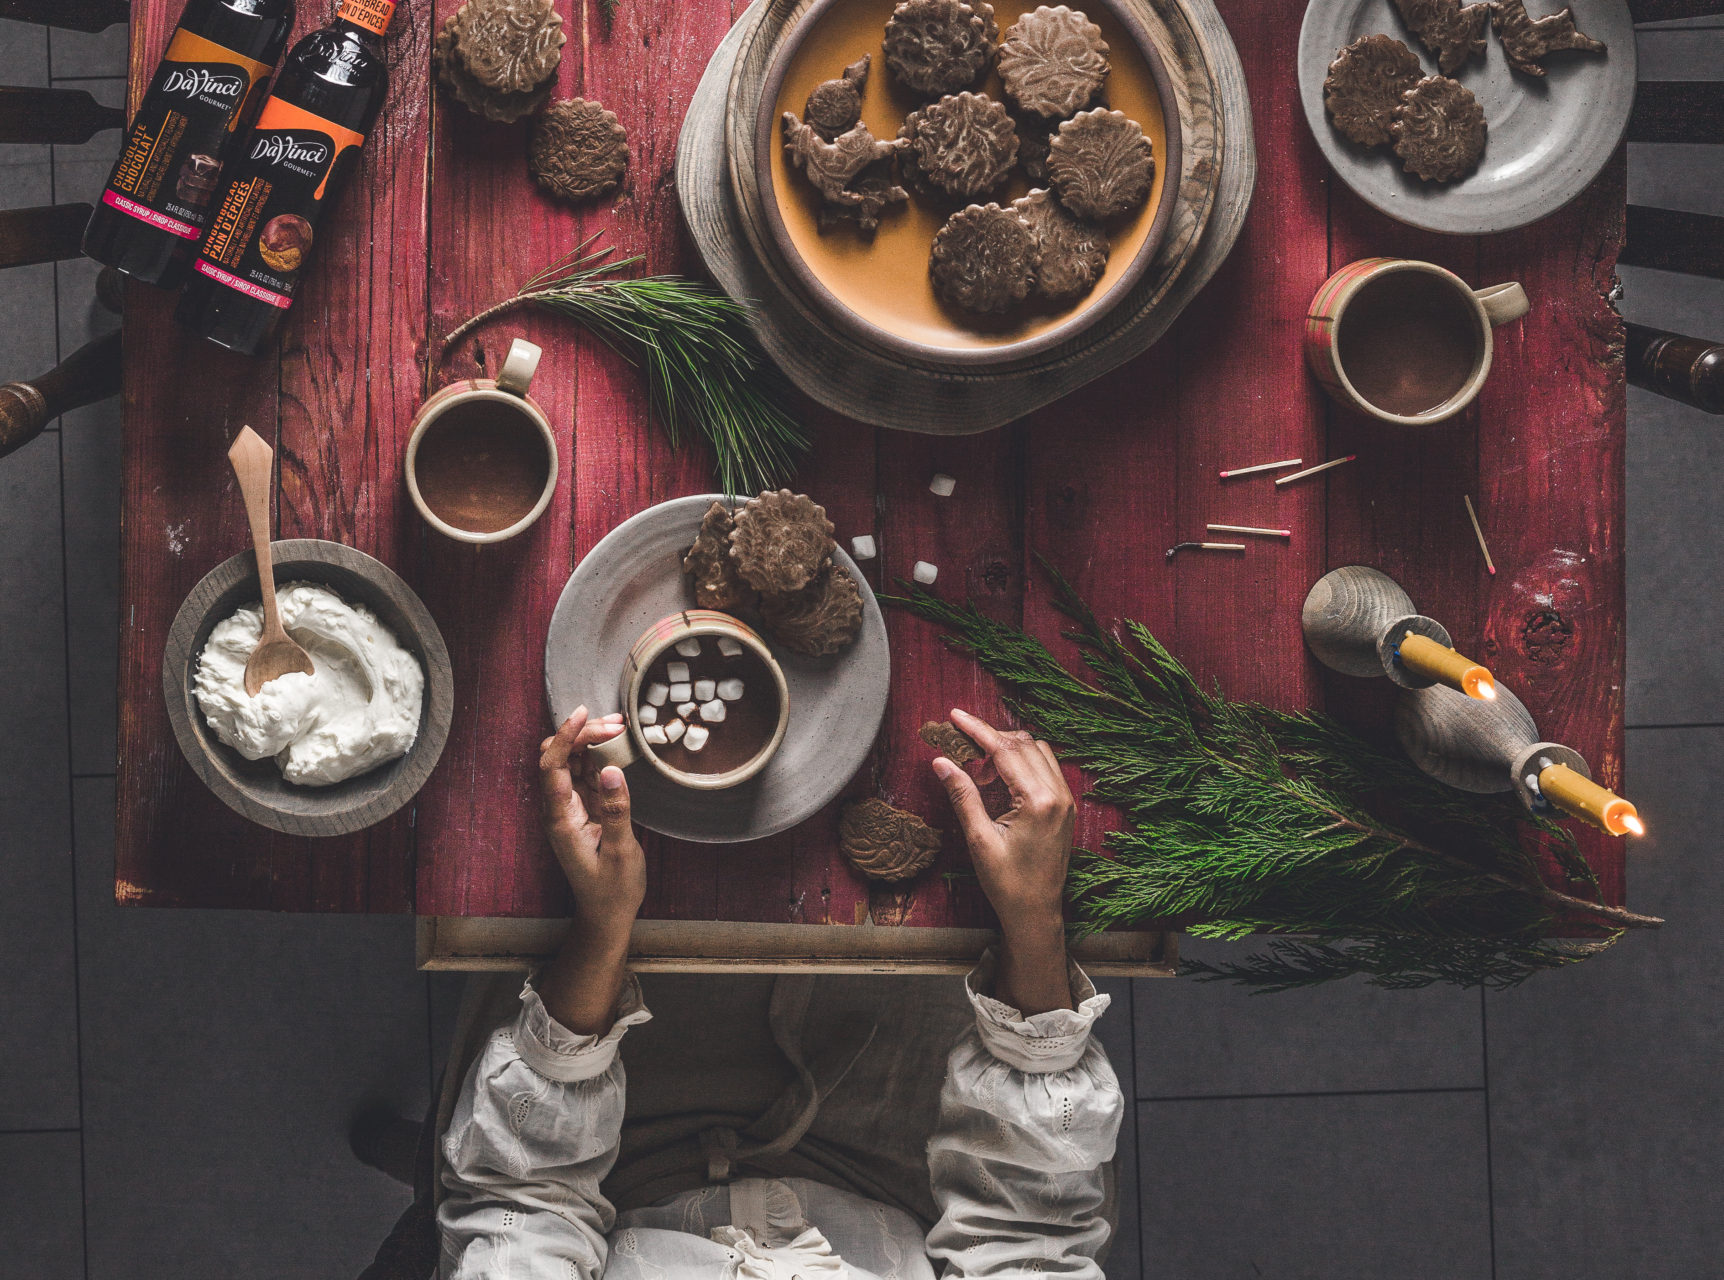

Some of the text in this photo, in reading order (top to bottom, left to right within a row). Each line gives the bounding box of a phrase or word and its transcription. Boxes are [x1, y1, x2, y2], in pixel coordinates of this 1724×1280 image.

[349, 3, 387, 30] D'ÉPICES
[162, 68, 242, 99] DaVinci
[199, 94, 230, 111] GOURMET
[113, 122, 147, 187] CHOCOLATE
[121, 133, 155, 193] CHOCOLAT
[251, 135, 328, 166] DaVinci
[283, 161, 315, 178] GOURMET
[114, 196, 134, 211] CLASSIC
[132, 204, 151, 218] SYRUP
[152, 213, 169, 226] SIROP
[167, 219, 192, 235] CLASSIQUE
[202, 180, 239, 255] GINGERBREAD
[209, 180, 250, 260] PAIN D'ÉPICES
[200, 263, 218, 277] CLASSIC
[215, 270, 233, 284] SYRUP
[234, 279, 251, 292] SIROP
[249, 286, 277, 303] CLASSIQUE
